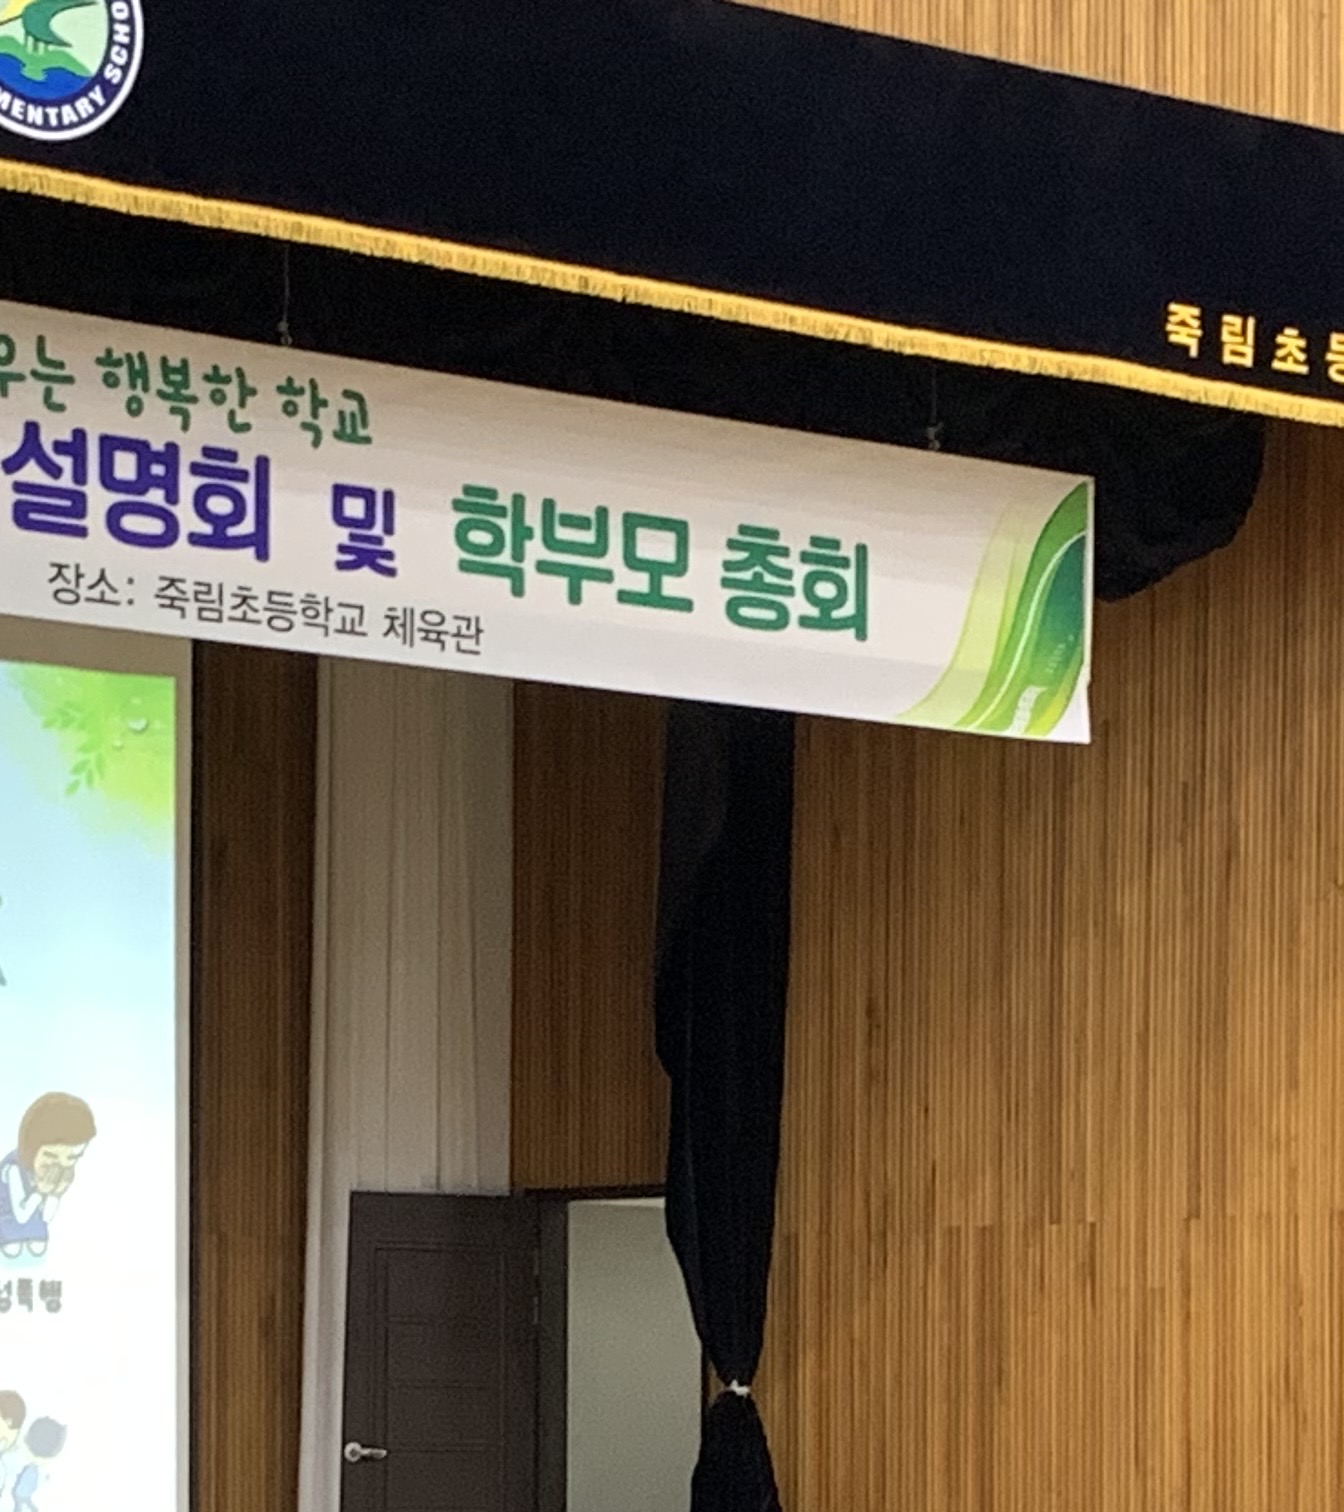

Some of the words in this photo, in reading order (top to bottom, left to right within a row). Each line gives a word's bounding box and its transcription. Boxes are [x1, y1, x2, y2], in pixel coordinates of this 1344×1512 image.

[94, 345, 258, 434] 행복한
[275, 374, 374, 450] 학교
[0, 419, 271, 563] 설명회
[330, 482, 399, 579] 및
[451, 482, 695, 614] 학부모
[719, 522, 869, 643] 총회
[47, 560, 137, 607] 장소:
[153, 573, 370, 637] 죽림초등학교
[381, 604, 485, 656] 체육관
